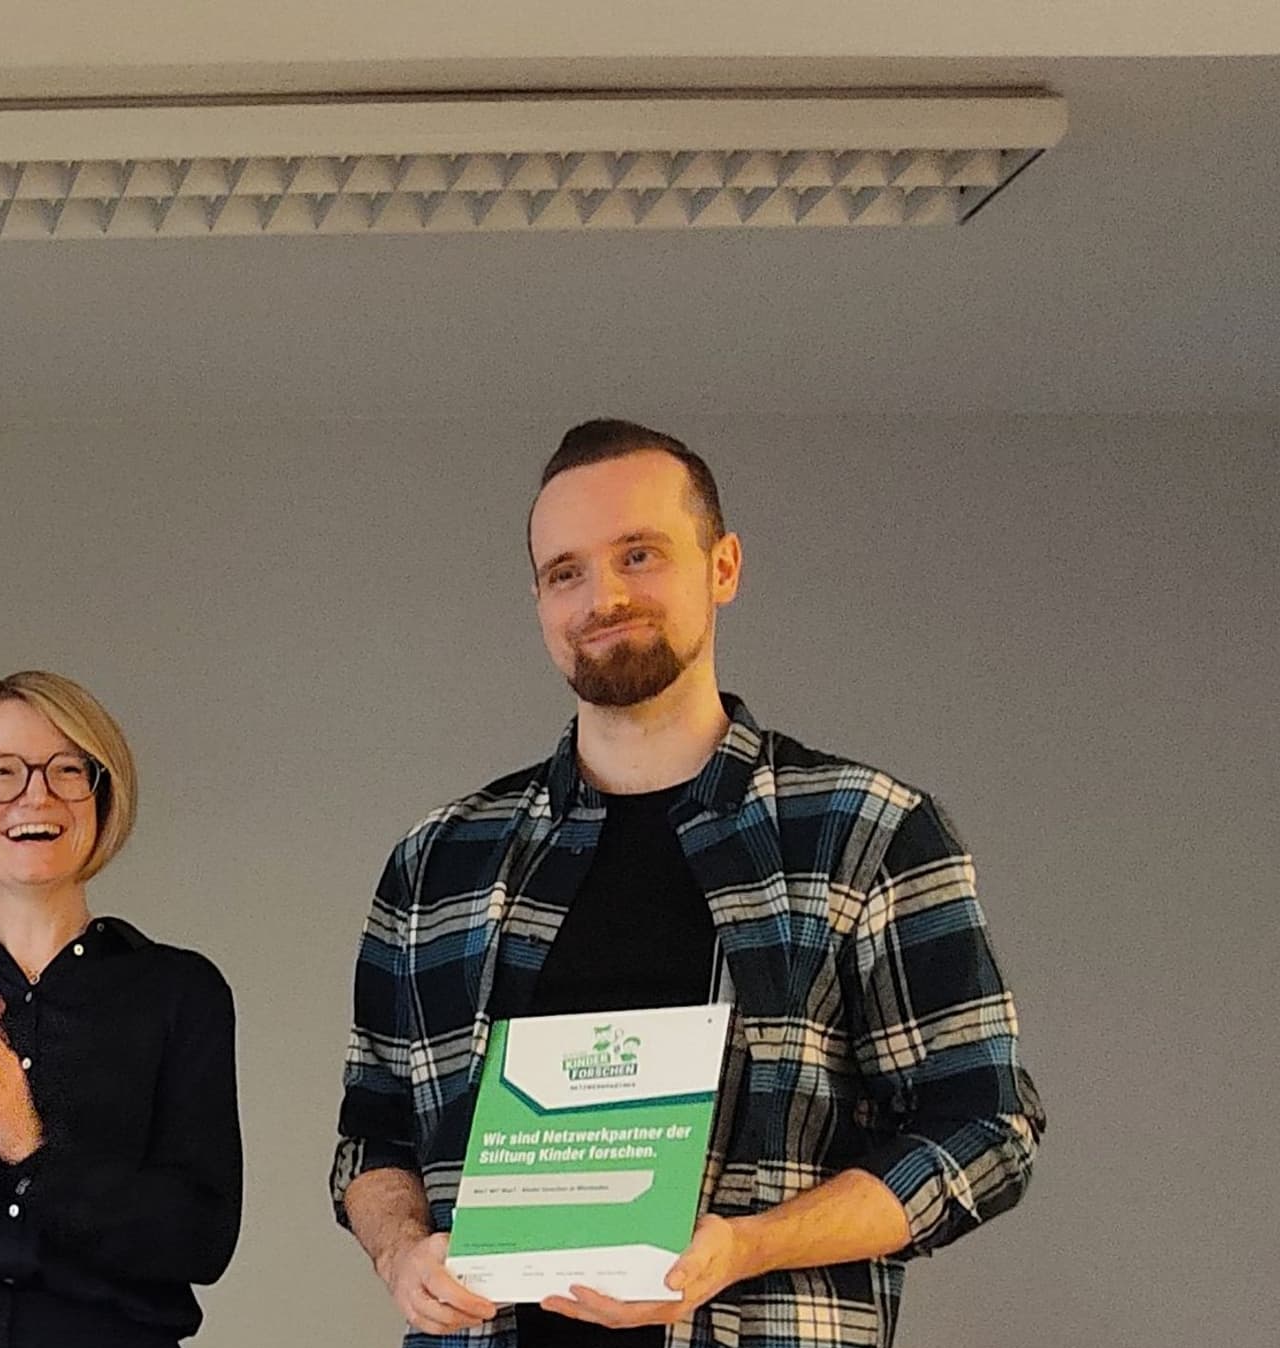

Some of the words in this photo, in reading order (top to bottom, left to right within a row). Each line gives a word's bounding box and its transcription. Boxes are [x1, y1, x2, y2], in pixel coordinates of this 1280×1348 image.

[483, 1132, 506, 1146] Wir
[510, 1131, 539, 1145] sind
[543, 1127, 662, 1144] Netzwerkpartner
[666, 1124, 692, 1139] der
[480, 1150, 535, 1165] Stiftung
[539, 1148, 585, 1161] Kinder
[589, 1145, 657, 1159] forschen.
